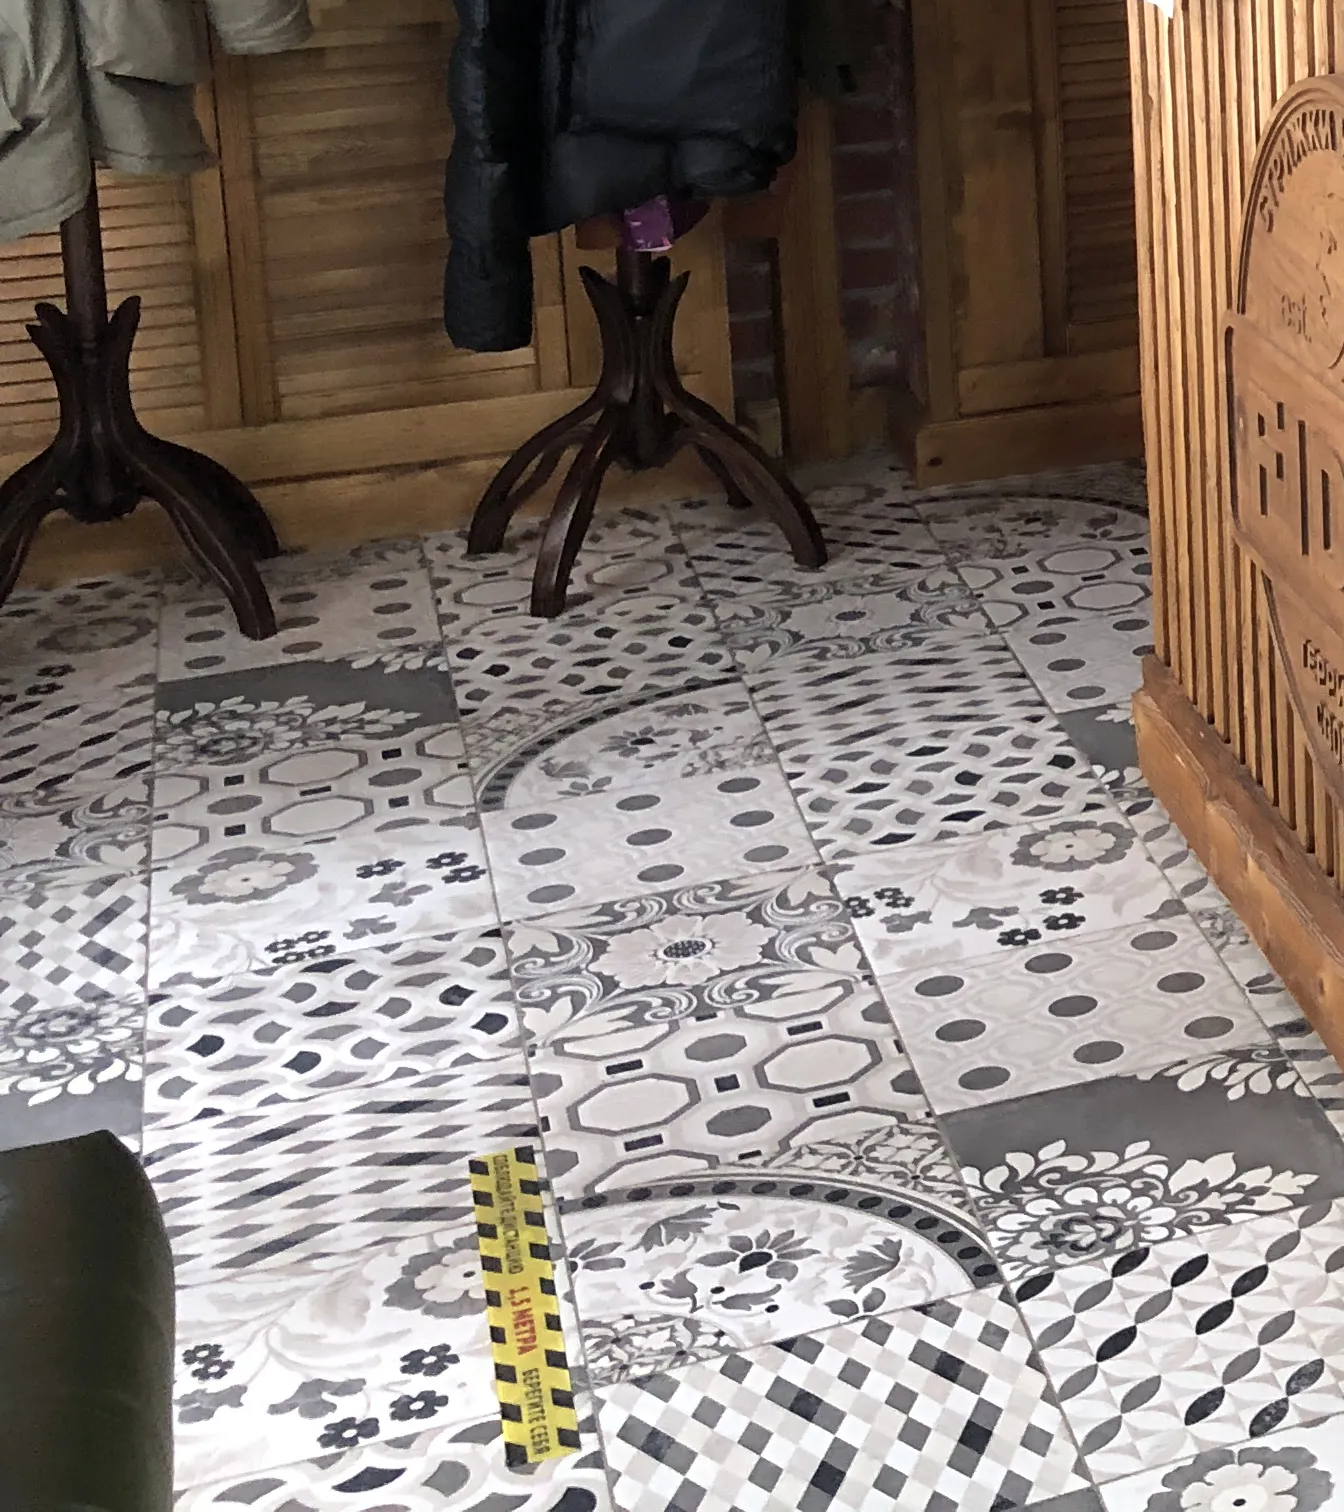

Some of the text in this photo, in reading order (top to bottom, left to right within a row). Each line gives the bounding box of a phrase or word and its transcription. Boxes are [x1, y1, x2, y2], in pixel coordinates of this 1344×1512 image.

[512, 1308, 538, 1356] МЕТРА
[522, 1367, 547, 1424] БЕРЕГИТЕ
[529, 1424, 552, 1456] СЕБЯ
